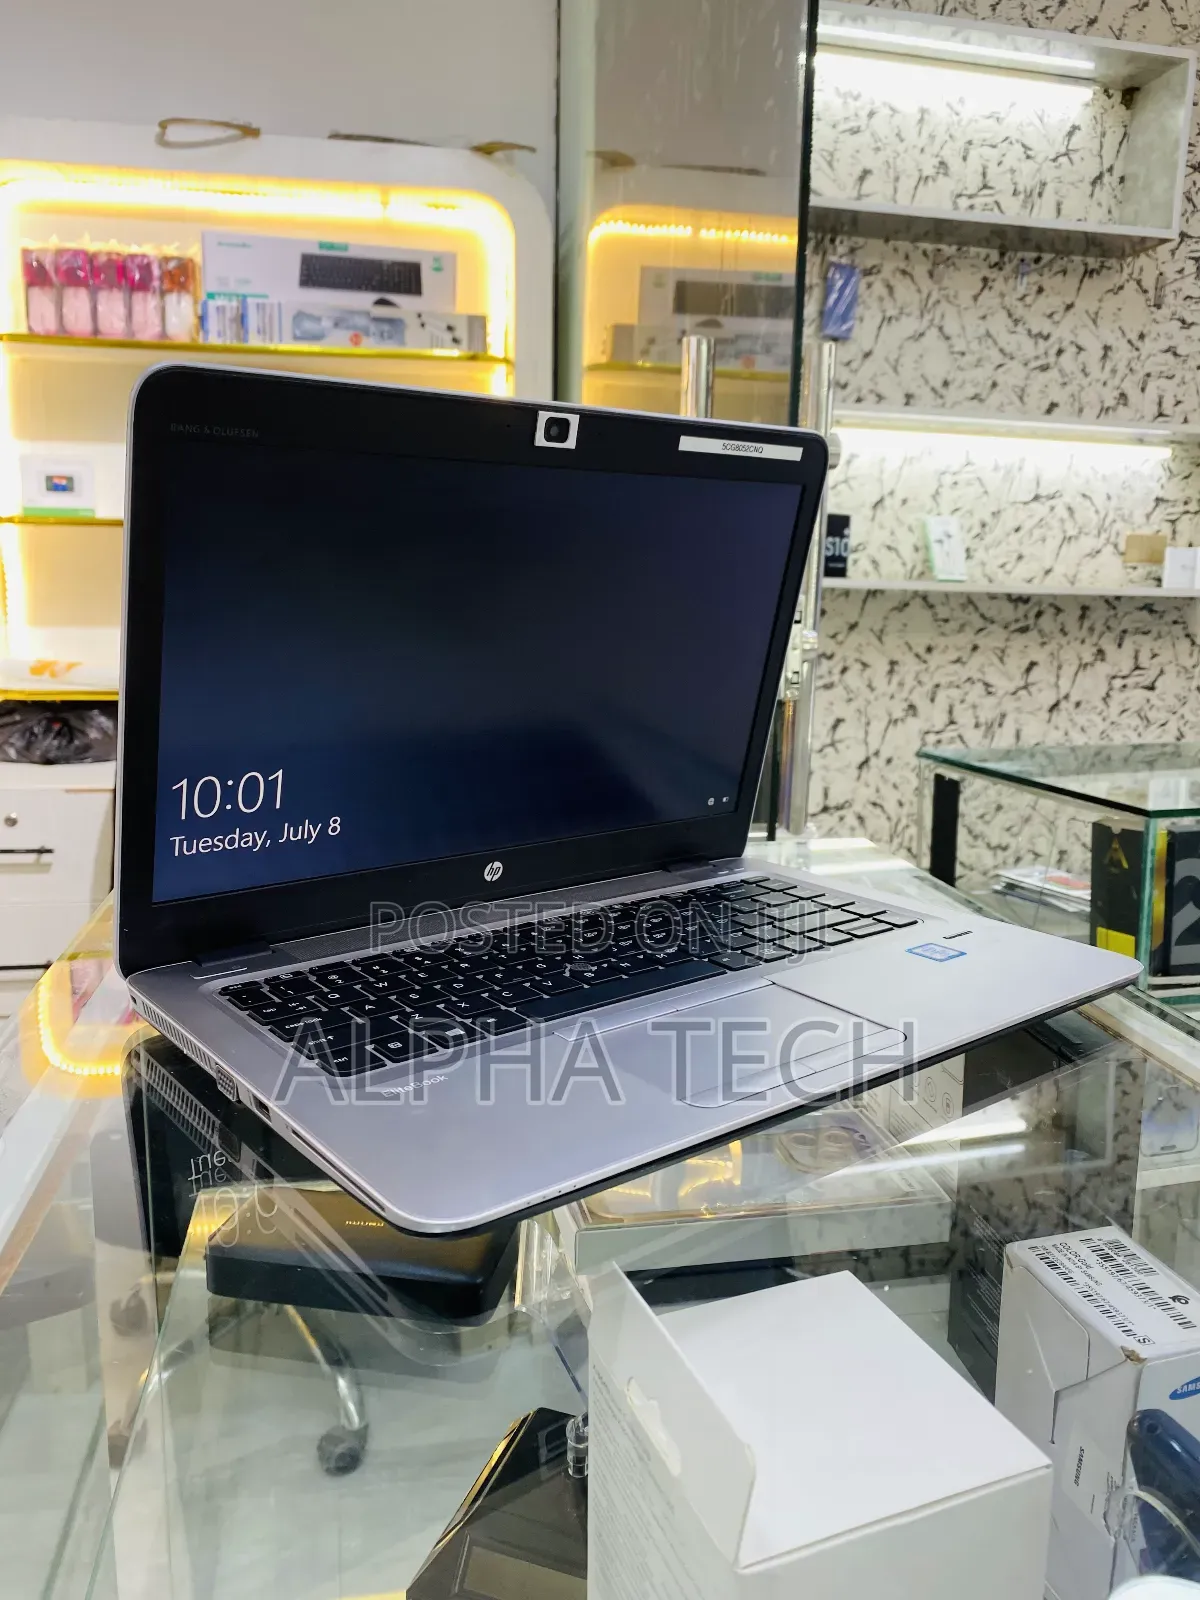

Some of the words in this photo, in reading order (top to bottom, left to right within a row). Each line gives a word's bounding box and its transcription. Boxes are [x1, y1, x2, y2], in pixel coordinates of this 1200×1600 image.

[213, 426, 259, 438] OLUFSEN
[171, 768, 284, 820] 10:01
[170, 827, 271, 857] Tuesday,
[279, 819, 322, 845] July
[327, 816, 342, 836] 8
[485, 861, 502, 881] hp
[381, 1075, 448, 1098] EliteBook
[1073, 1446, 1085, 1487] SAMSUNG
